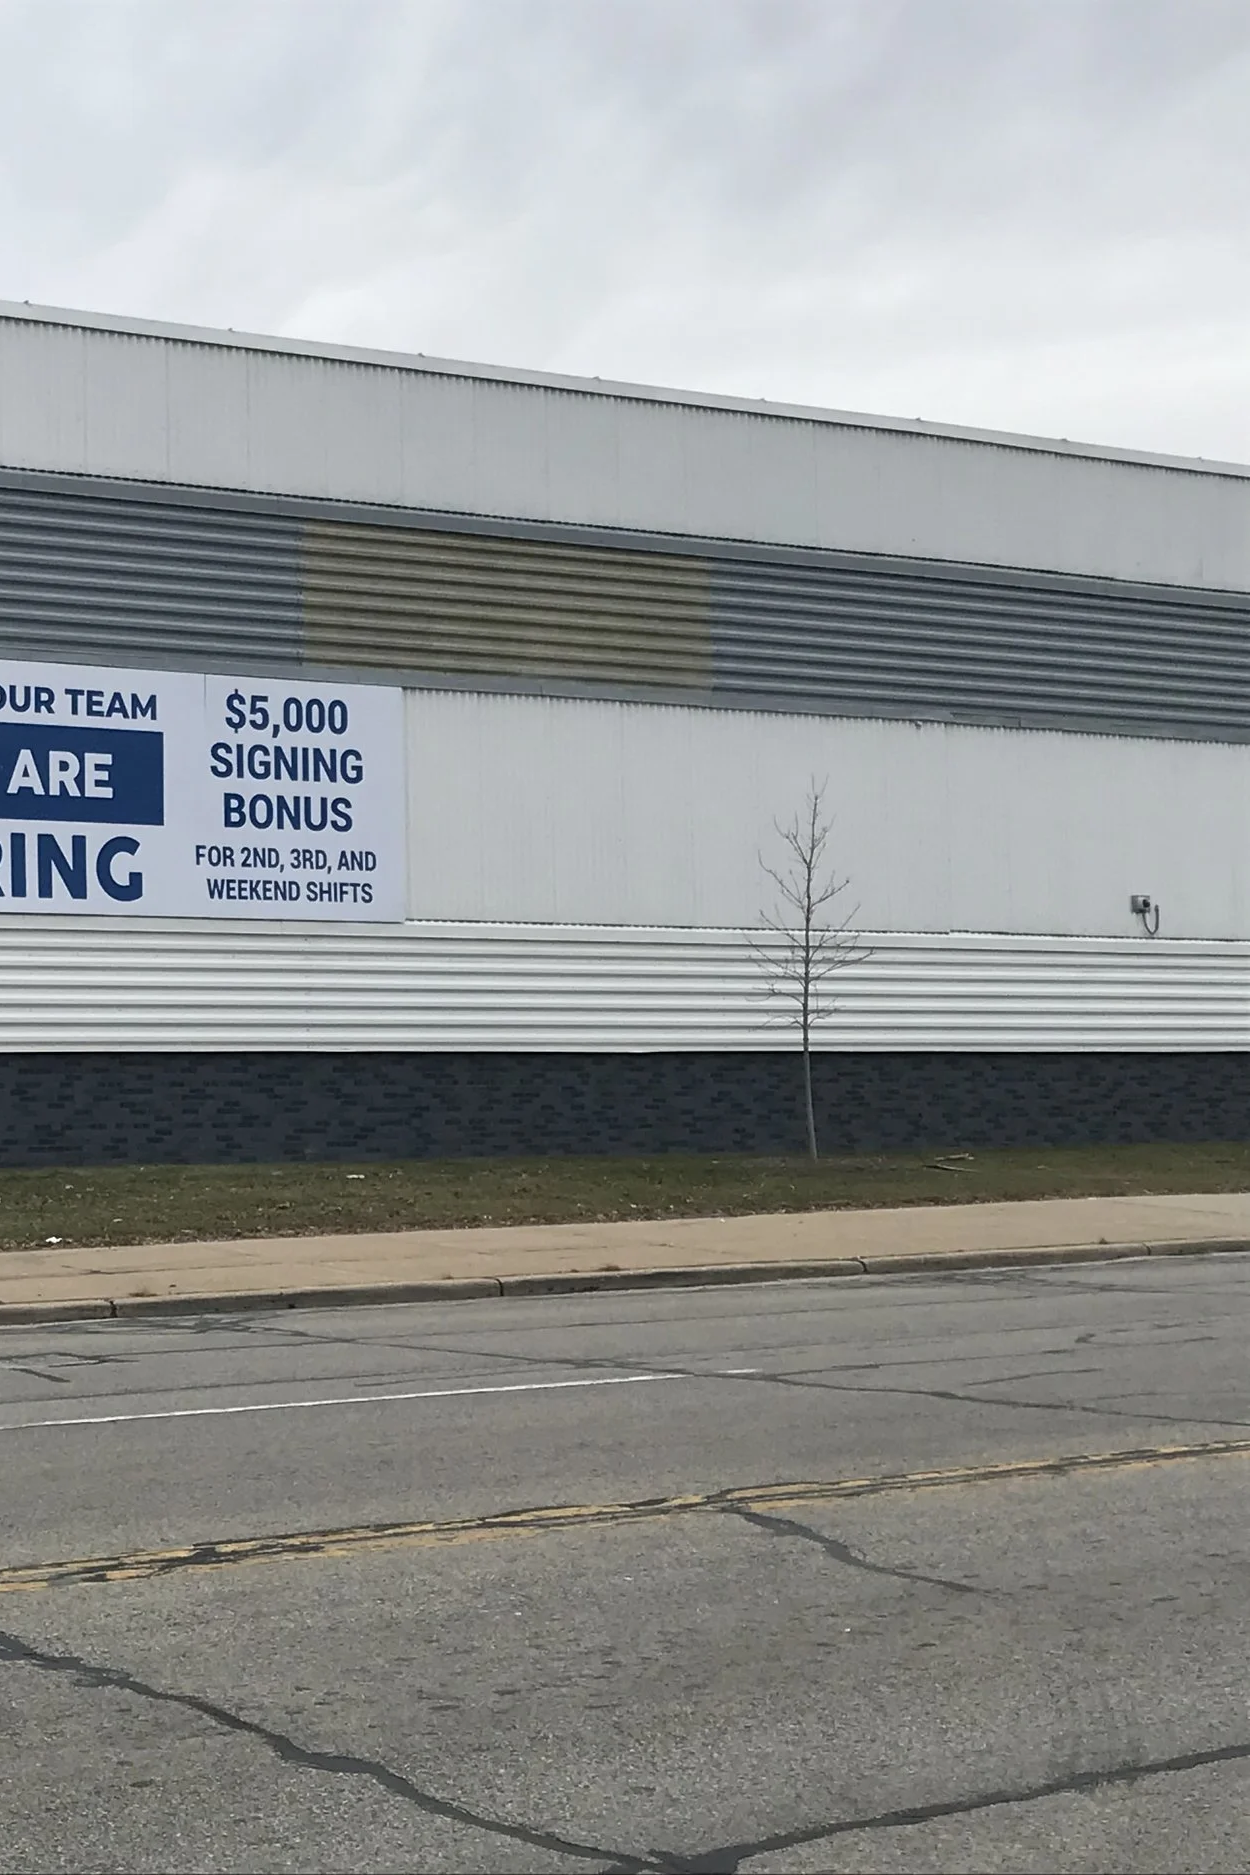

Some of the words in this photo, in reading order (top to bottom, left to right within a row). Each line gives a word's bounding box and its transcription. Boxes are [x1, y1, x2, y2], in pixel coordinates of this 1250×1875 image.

[64, 687, 158, 721] TEAM
[224, 688, 349, 739] $5,000
[7, 749, 114, 799] ARE
[209, 741, 364, 785] SIGNING
[223, 792, 353, 833] BONUS
[195, 844, 236, 868] FOR
[240, 846, 285, 874] 2ND,
[289, 847, 332, 875] 3RD,
[336, 849, 377, 872] AND
[205, 877, 301, 902] WEEKEND
[305, 880, 374, 904] SHIFTS
